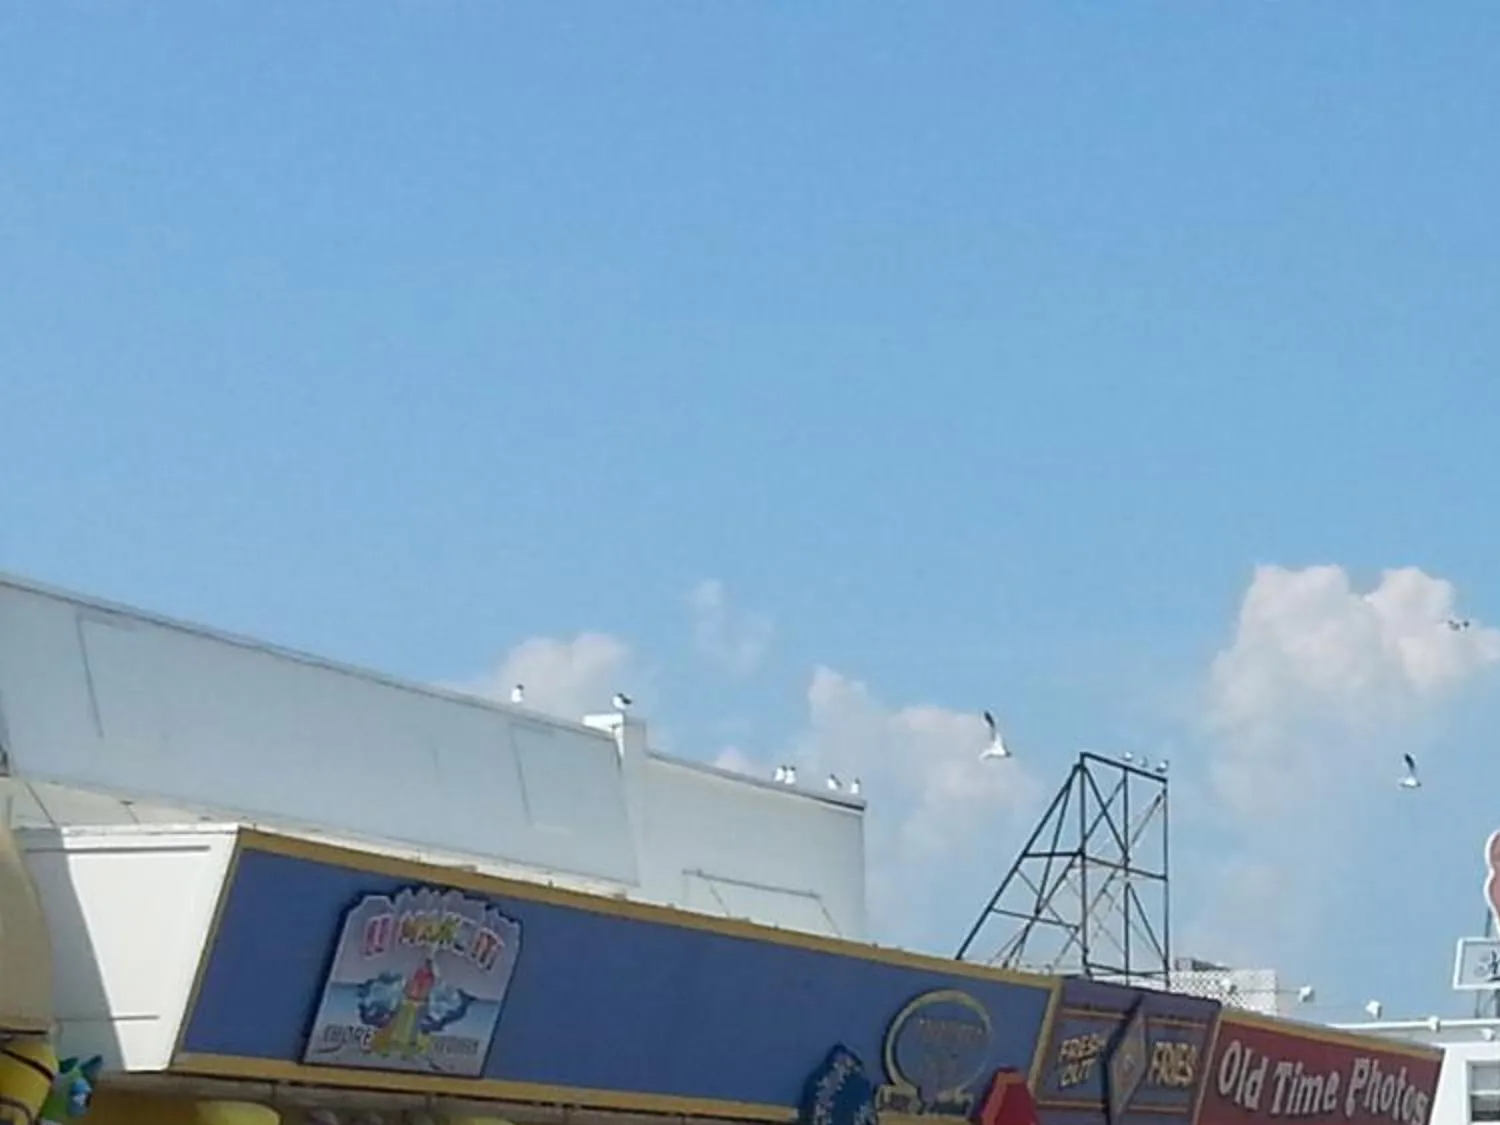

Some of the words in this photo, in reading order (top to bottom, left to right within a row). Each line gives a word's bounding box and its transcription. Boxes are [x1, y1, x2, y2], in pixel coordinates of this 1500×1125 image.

[1149, 1040, 1197, 1086] FRIES
[1217, 1039, 1268, 1111] Old
[1270, 1060, 1340, 1116] Time
